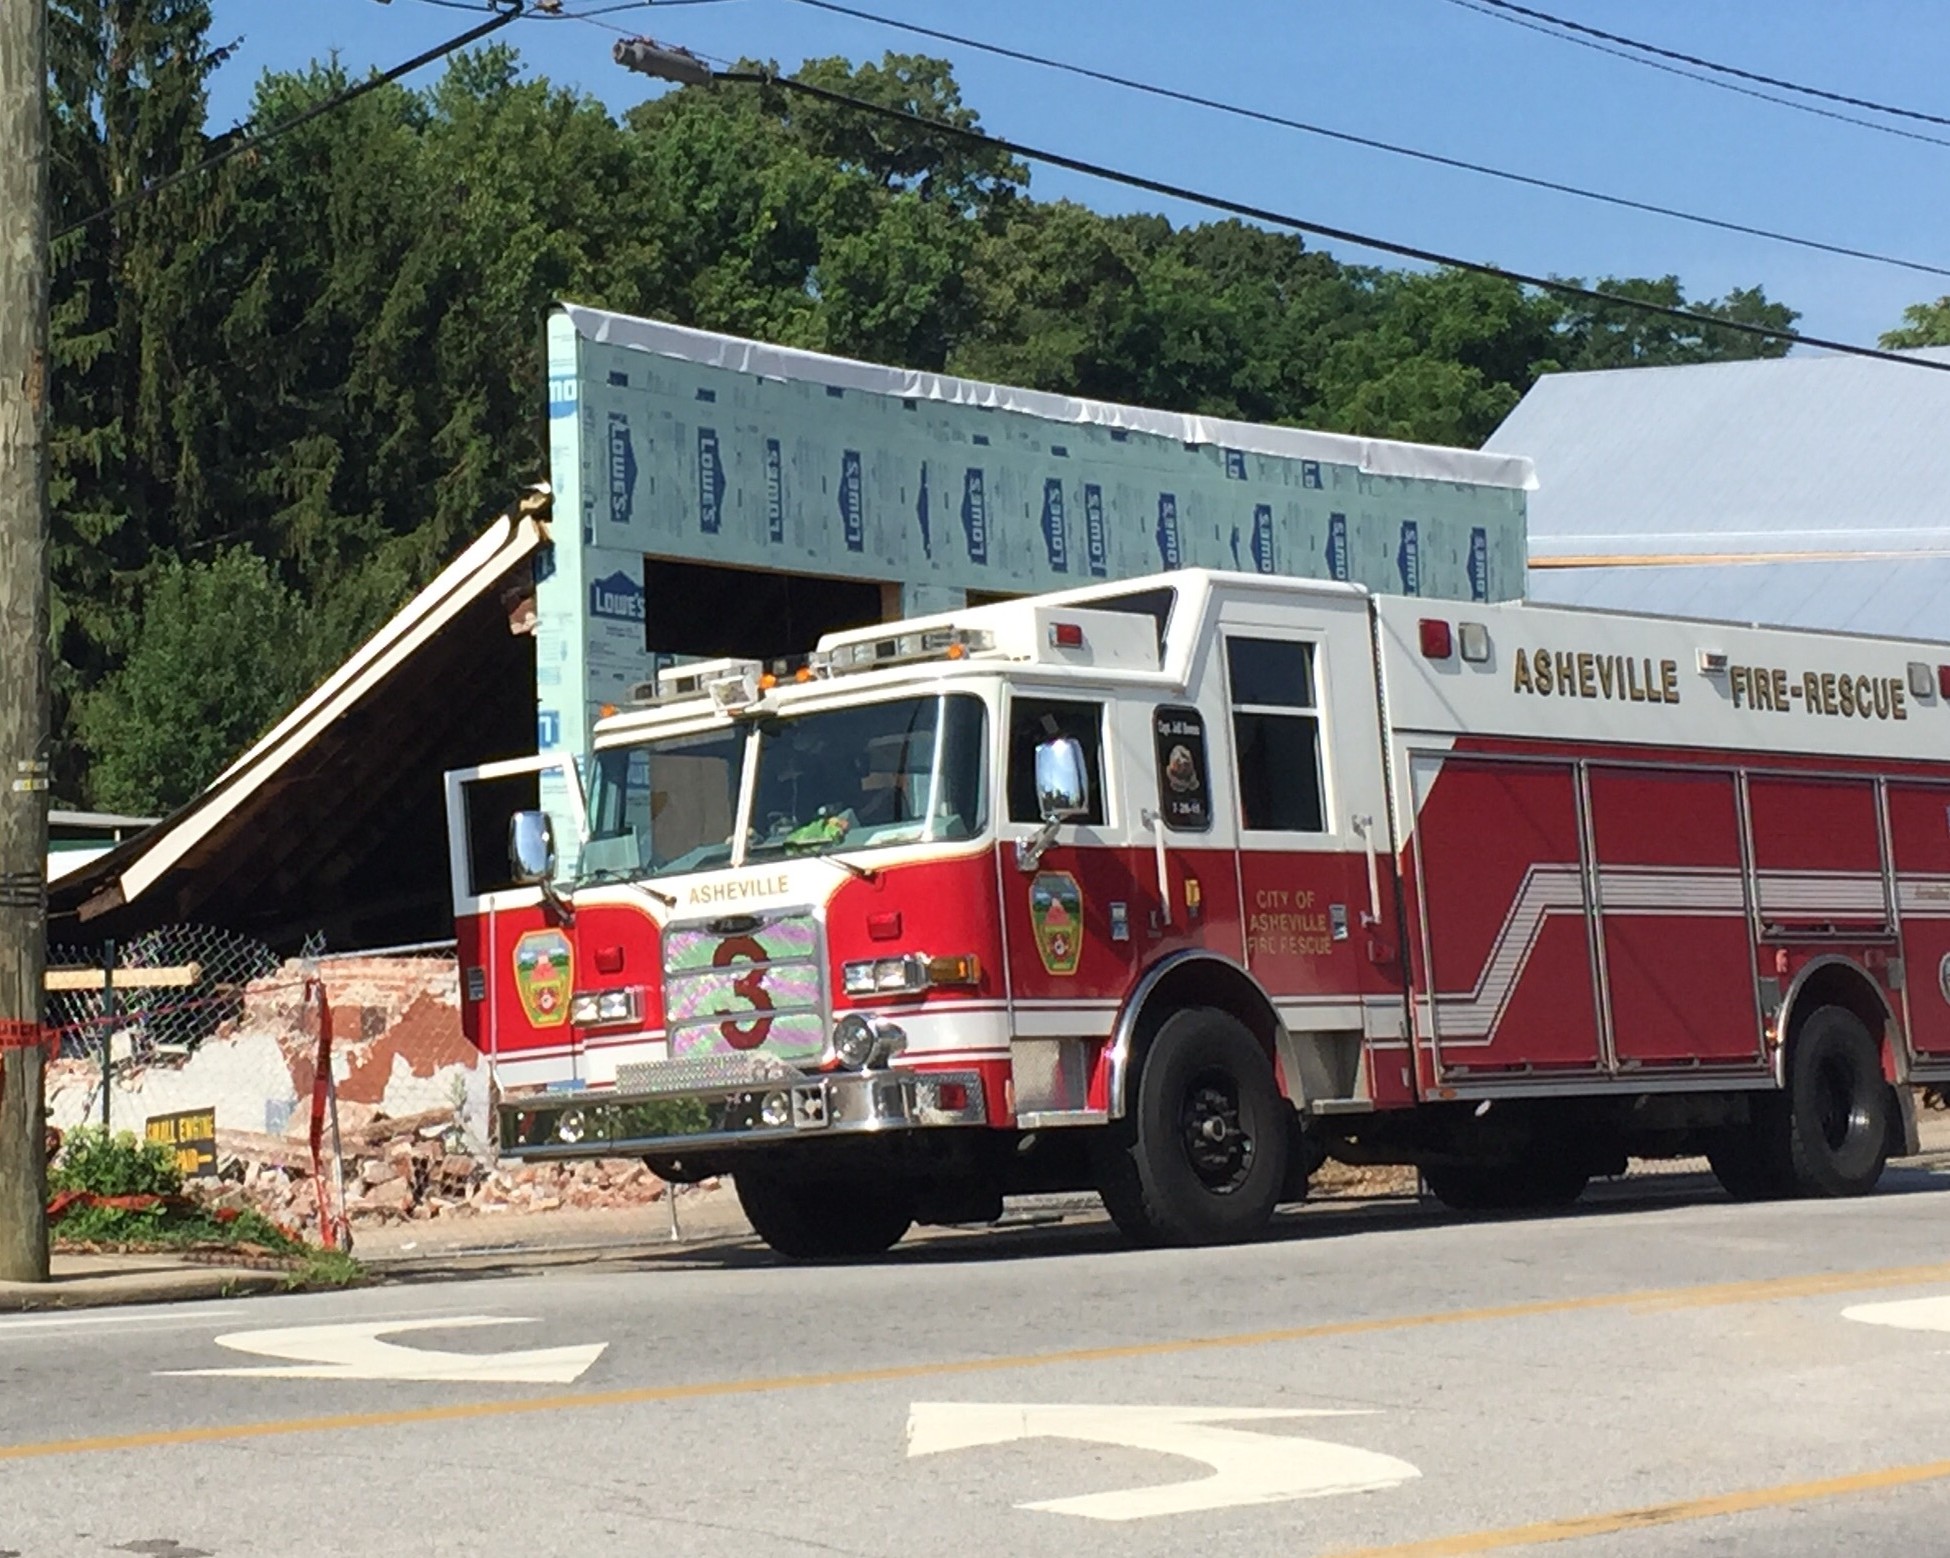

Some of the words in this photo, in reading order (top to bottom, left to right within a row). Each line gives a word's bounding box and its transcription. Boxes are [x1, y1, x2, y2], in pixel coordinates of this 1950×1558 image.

[700, 437, 717, 524] LOWE'S
[846, 460, 861, 543] LOWE'S
[969, 478, 984, 557] LOWE'S
[1050, 488, 1065, 565] LOWE'S
[1087, 493, 1105, 569] LOWE'S
[1257, 513, 1272, 573] OWE'S
[1331, 522, 1347, 581] OWE'S
[596, 586, 645, 619] LOWE'S
[1513, 648, 1680, 703] ASHEVILLE
[1729, 665, 1908, 720] FIRE-RESCUE
[689, 875, 789, 904] ASHEVILLE
[1250, 913, 1327, 932] ASHEVILLE
[1256, 889, 1289, 909] CITY
[1295, 889, 1315, 909] OF
[1280, 936, 1333, 955] RESCUE
[713, 934, 775, 1050] 3
